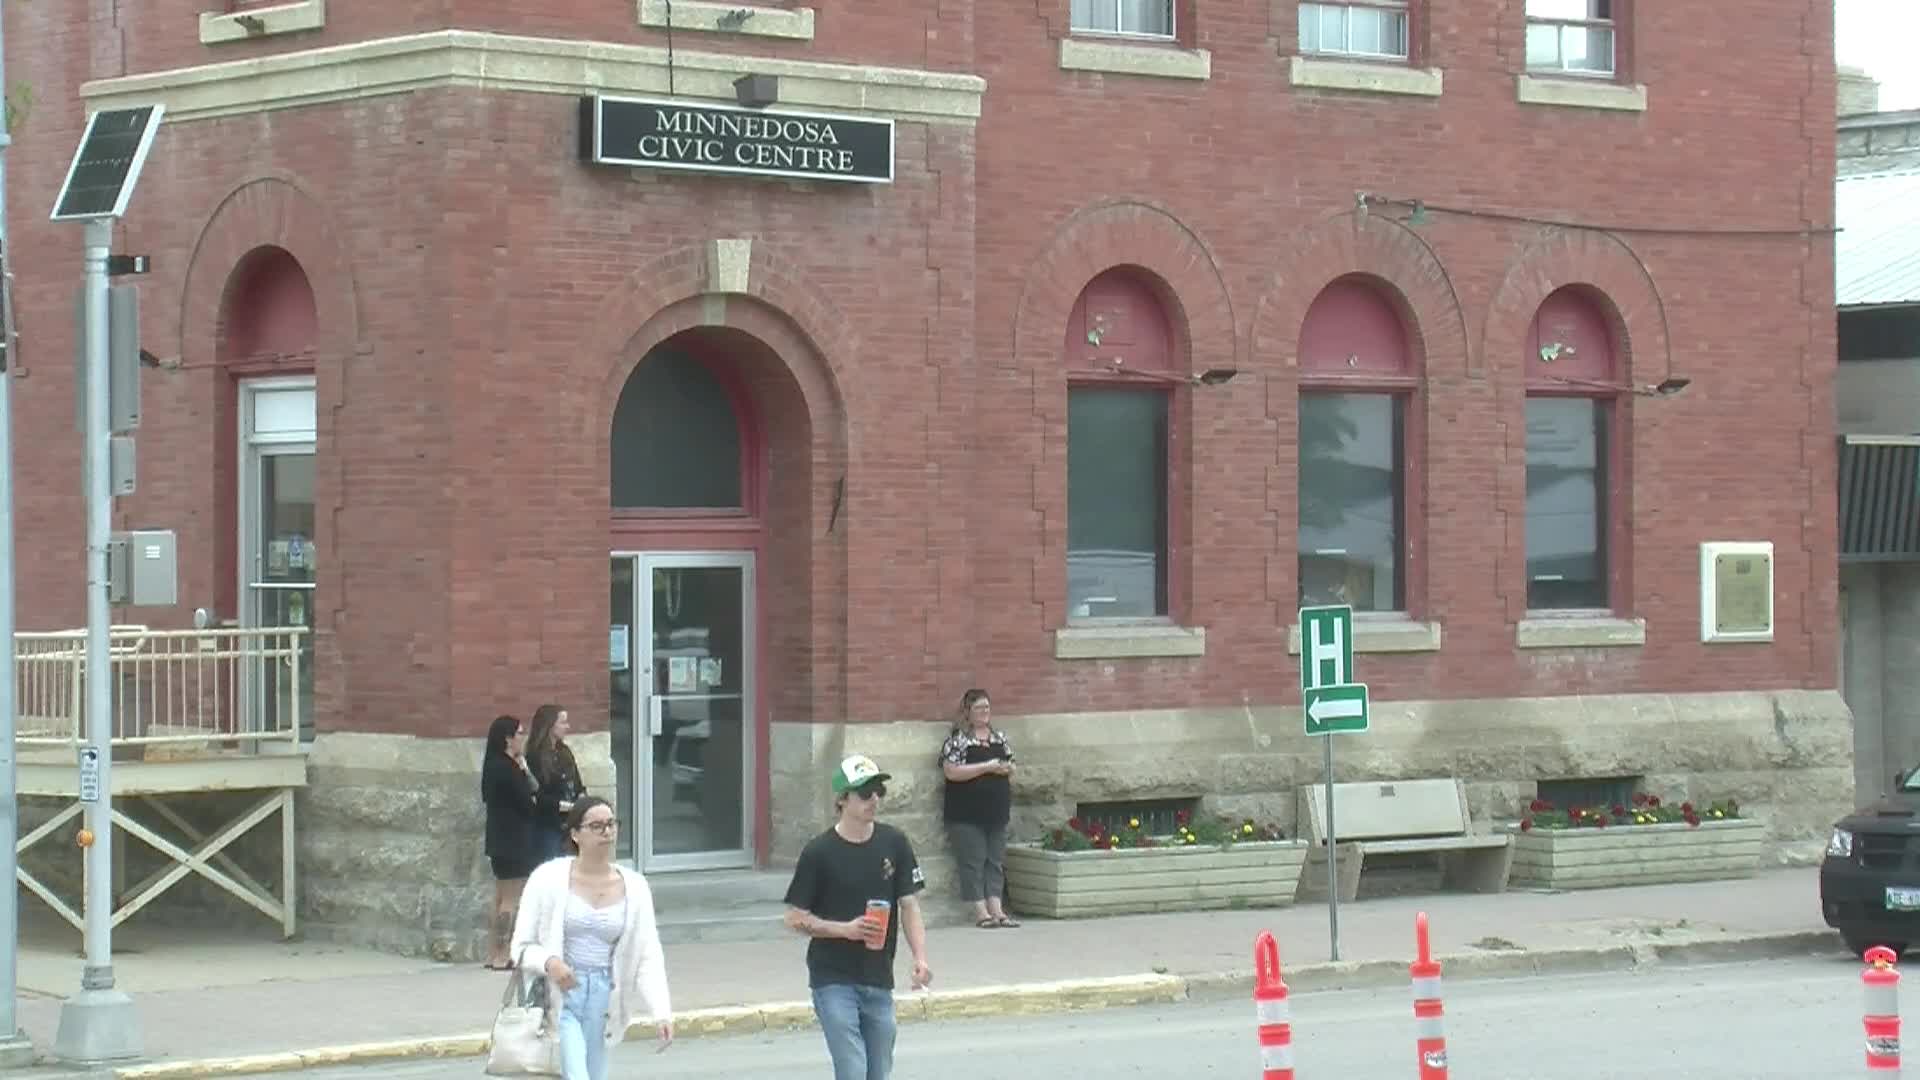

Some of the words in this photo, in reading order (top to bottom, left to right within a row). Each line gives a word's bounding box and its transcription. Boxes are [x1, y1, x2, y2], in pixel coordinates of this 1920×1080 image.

[655, 110, 839, 145] MINNEDOSA
[637, 136, 724, 162] CIVIC
[733, 143, 855, 172] CENTRE
[1310, 617, 1344, 688] H
